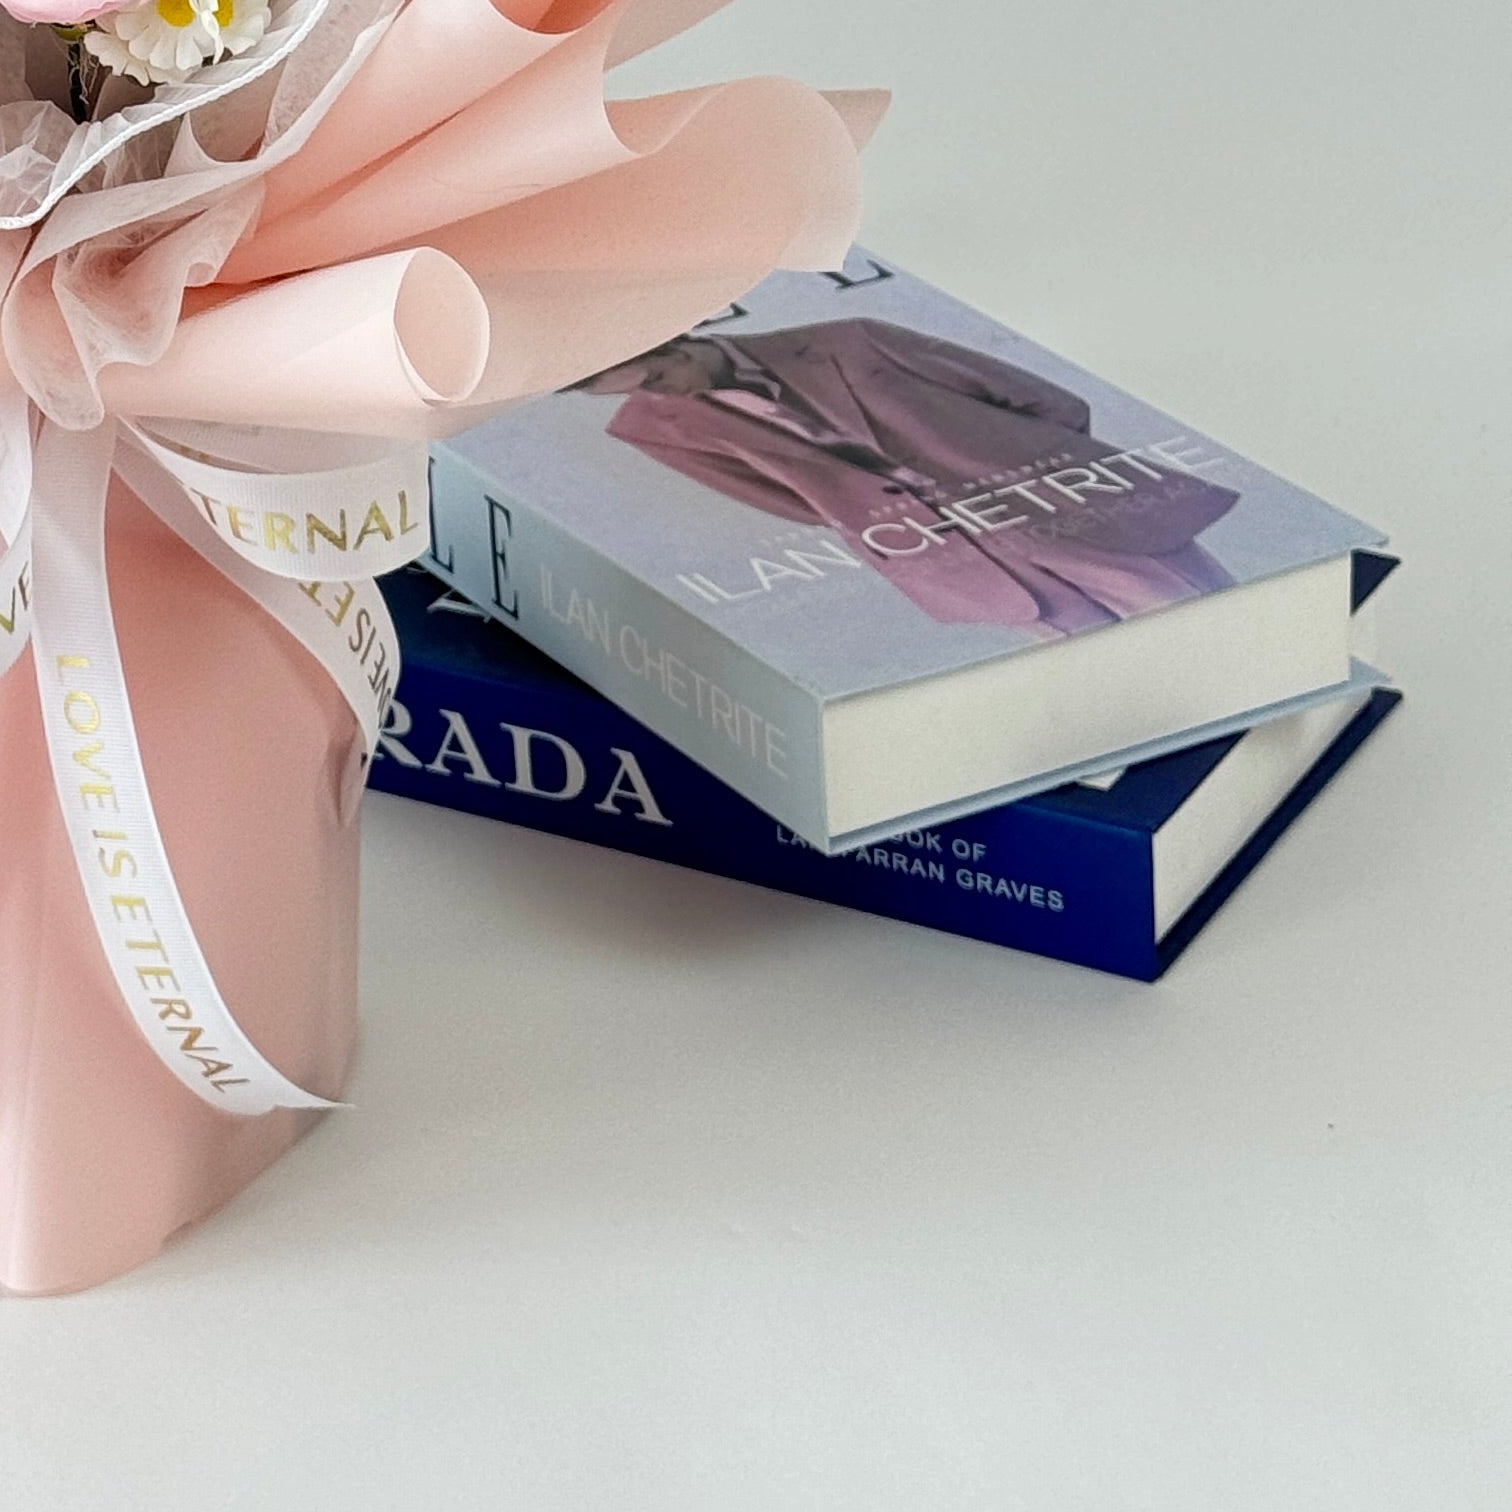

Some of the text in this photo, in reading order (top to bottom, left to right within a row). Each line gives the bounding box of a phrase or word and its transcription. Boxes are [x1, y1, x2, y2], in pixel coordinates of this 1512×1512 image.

[189, 487, 420, 554] TERNAL
[675, 540, 863, 604] ILAN
[861, 436, 1225, 557] CHETRITE
[374, 697, 674, 826] RADA
[619, 625, 789, 779] CHETRITE
[56, 653, 251, 1094] LOVE IS ETERNAL
[844, 846, 945, 884] ARRAN
[955, 867, 1066, 913] GRAVES
[951, 838, 988, 863] OF
